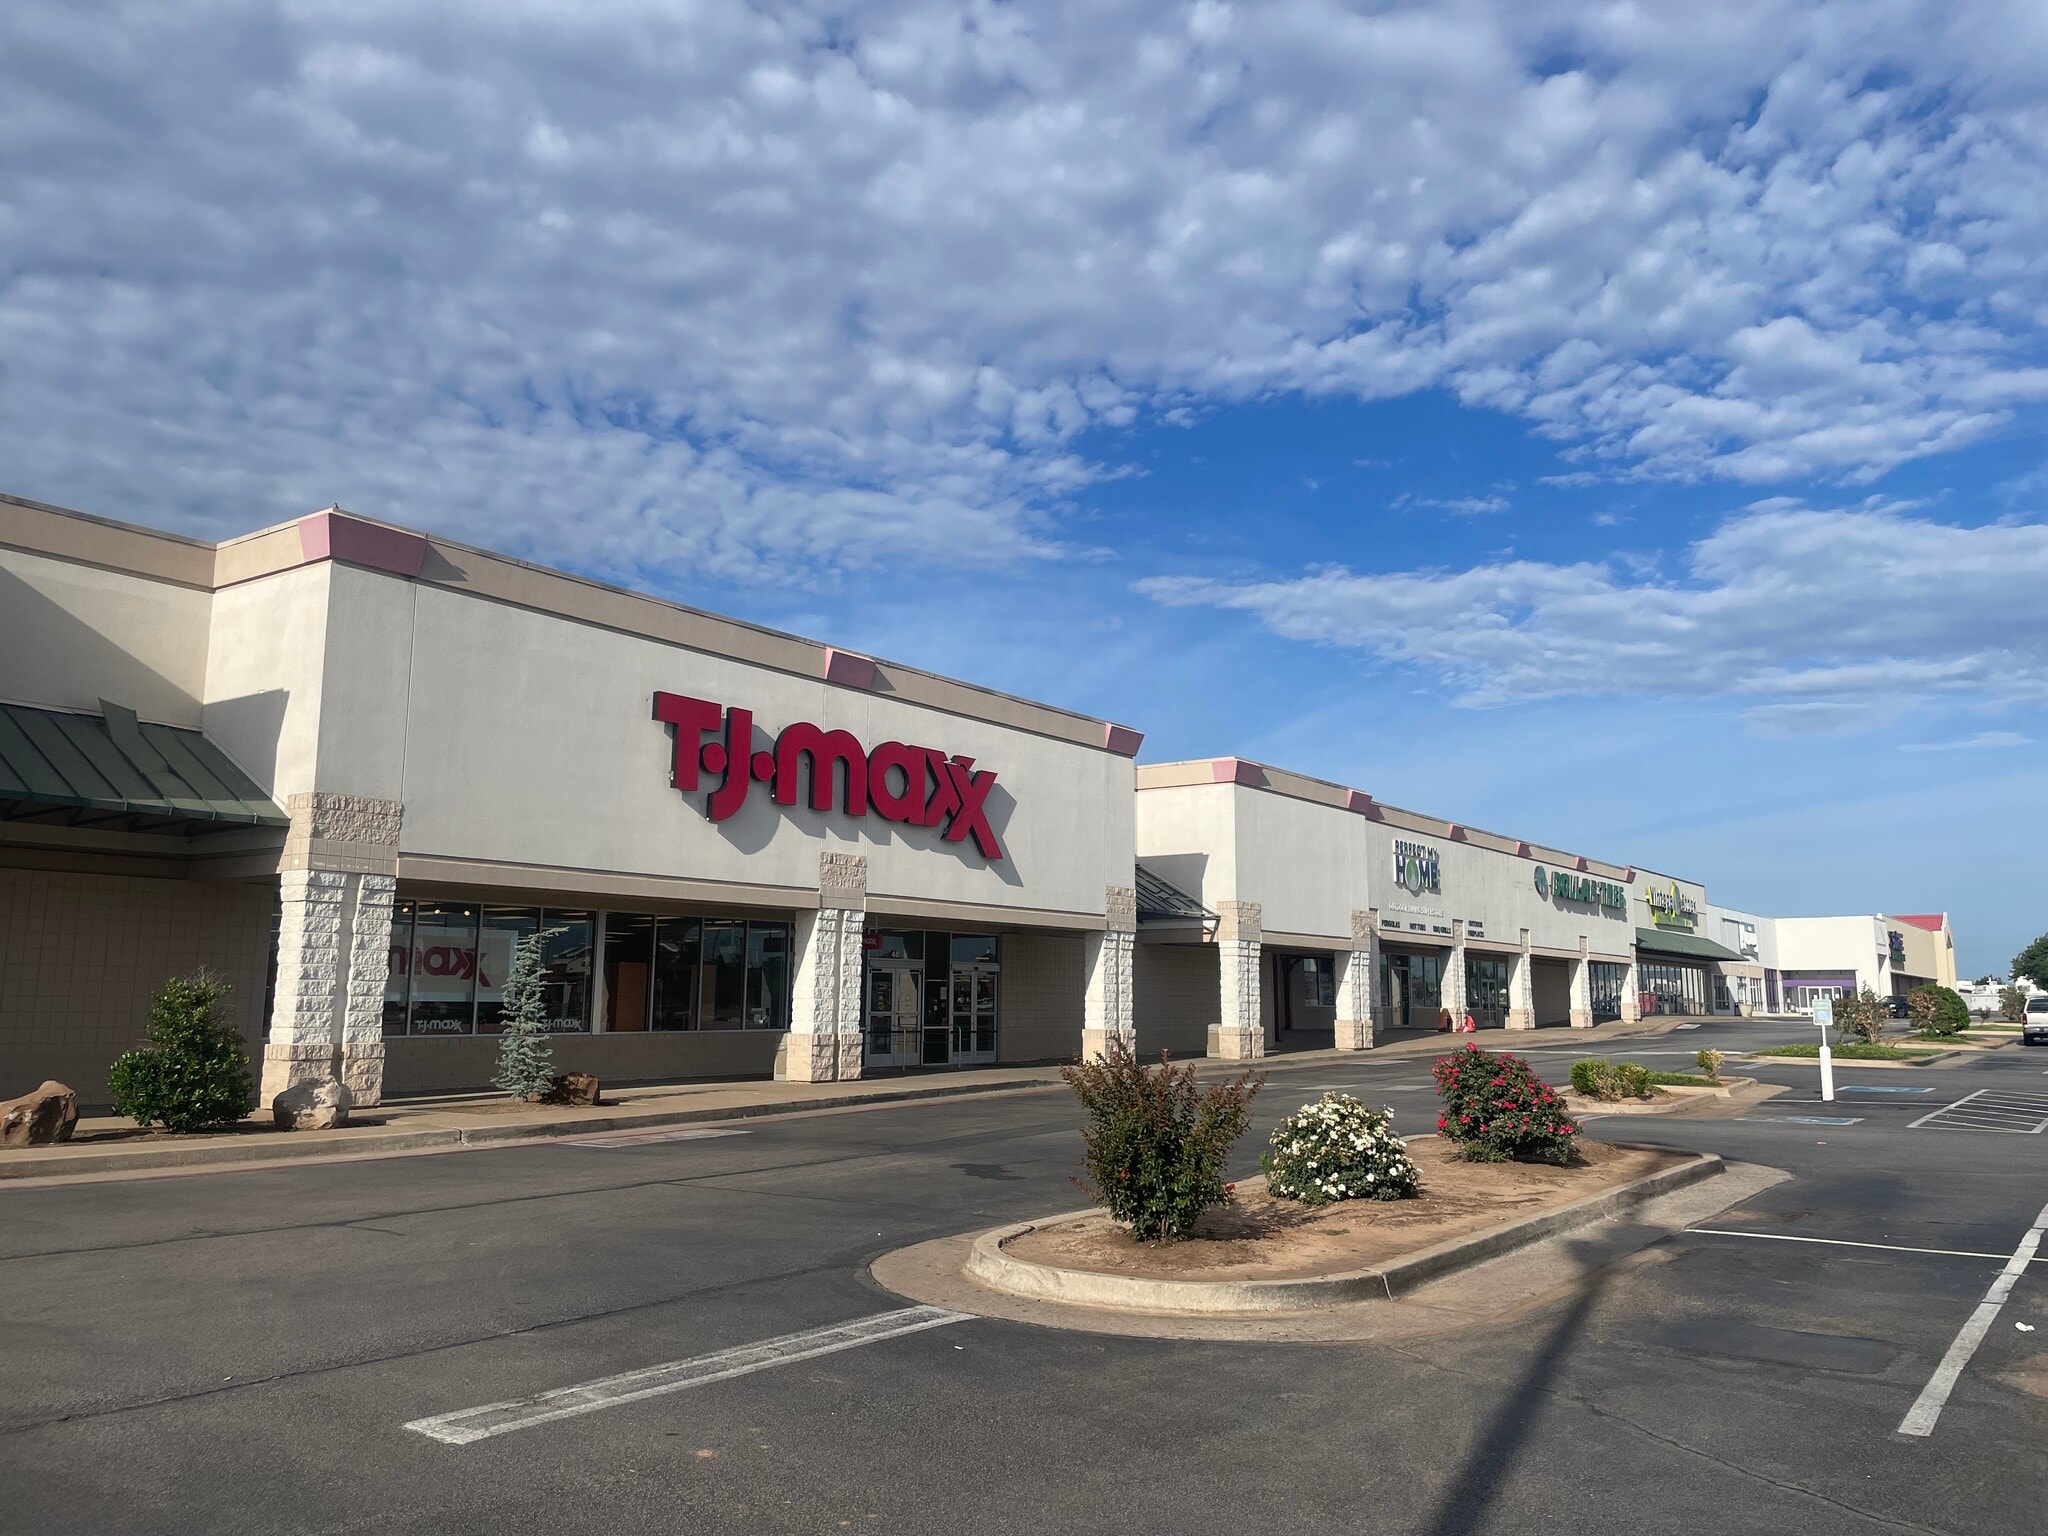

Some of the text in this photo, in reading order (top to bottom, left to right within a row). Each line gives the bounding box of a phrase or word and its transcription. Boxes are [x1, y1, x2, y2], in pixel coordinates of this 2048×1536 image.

[1393, 839, 1438, 860] PERFECT MY
[1393, 855, 1439, 890] HOME
[1551, 872, 1625, 908] DOLLAR TREE
